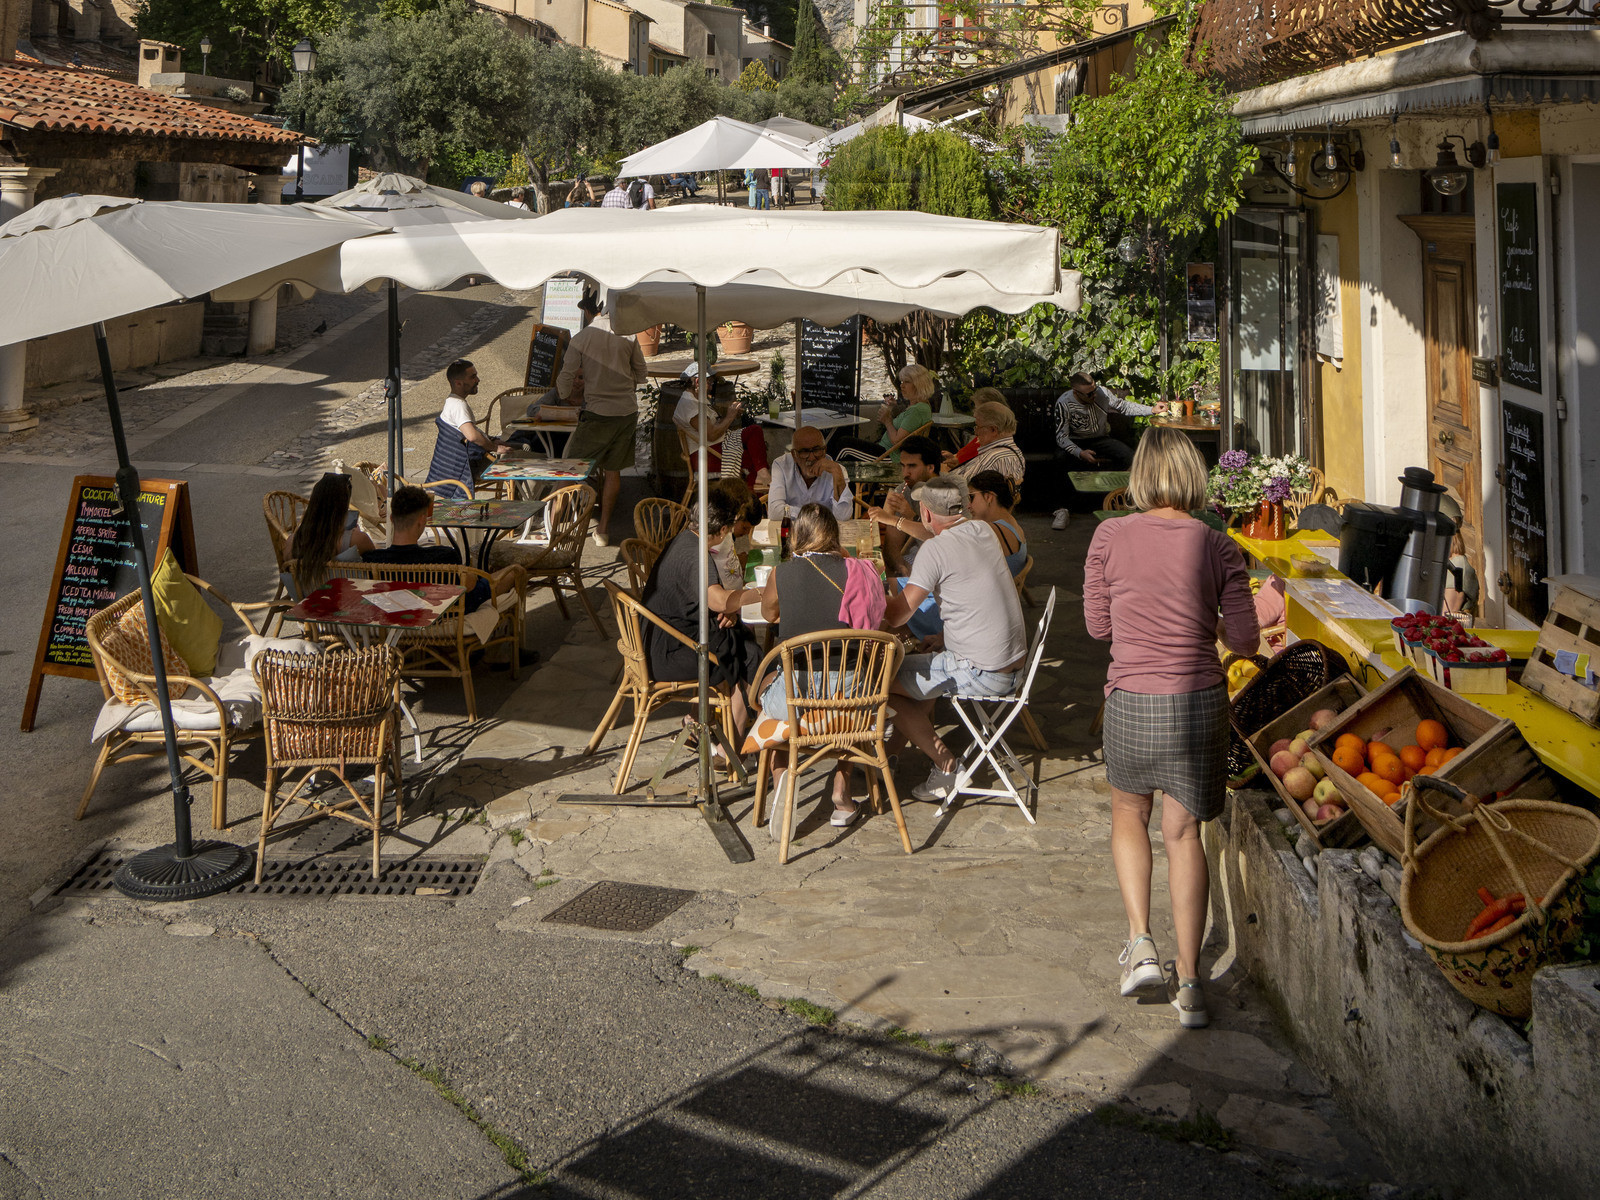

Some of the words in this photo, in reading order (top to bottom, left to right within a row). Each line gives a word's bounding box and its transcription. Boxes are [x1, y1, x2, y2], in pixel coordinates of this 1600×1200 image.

[1507, 347, 1536, 372] Formule
[136, 492, 166, 506] NATURE
[80, 502, 112, 518] IMMORTEL
[75, 525, 96, 537] APEROL
[71, 541, 94, 556] CÉSAR
[61, 585, 79, 597] ICED
[79, 587, 92, 598] TEA
[75, 606, 89, 617] HOME
[53, 623, 75, 635] COMME
